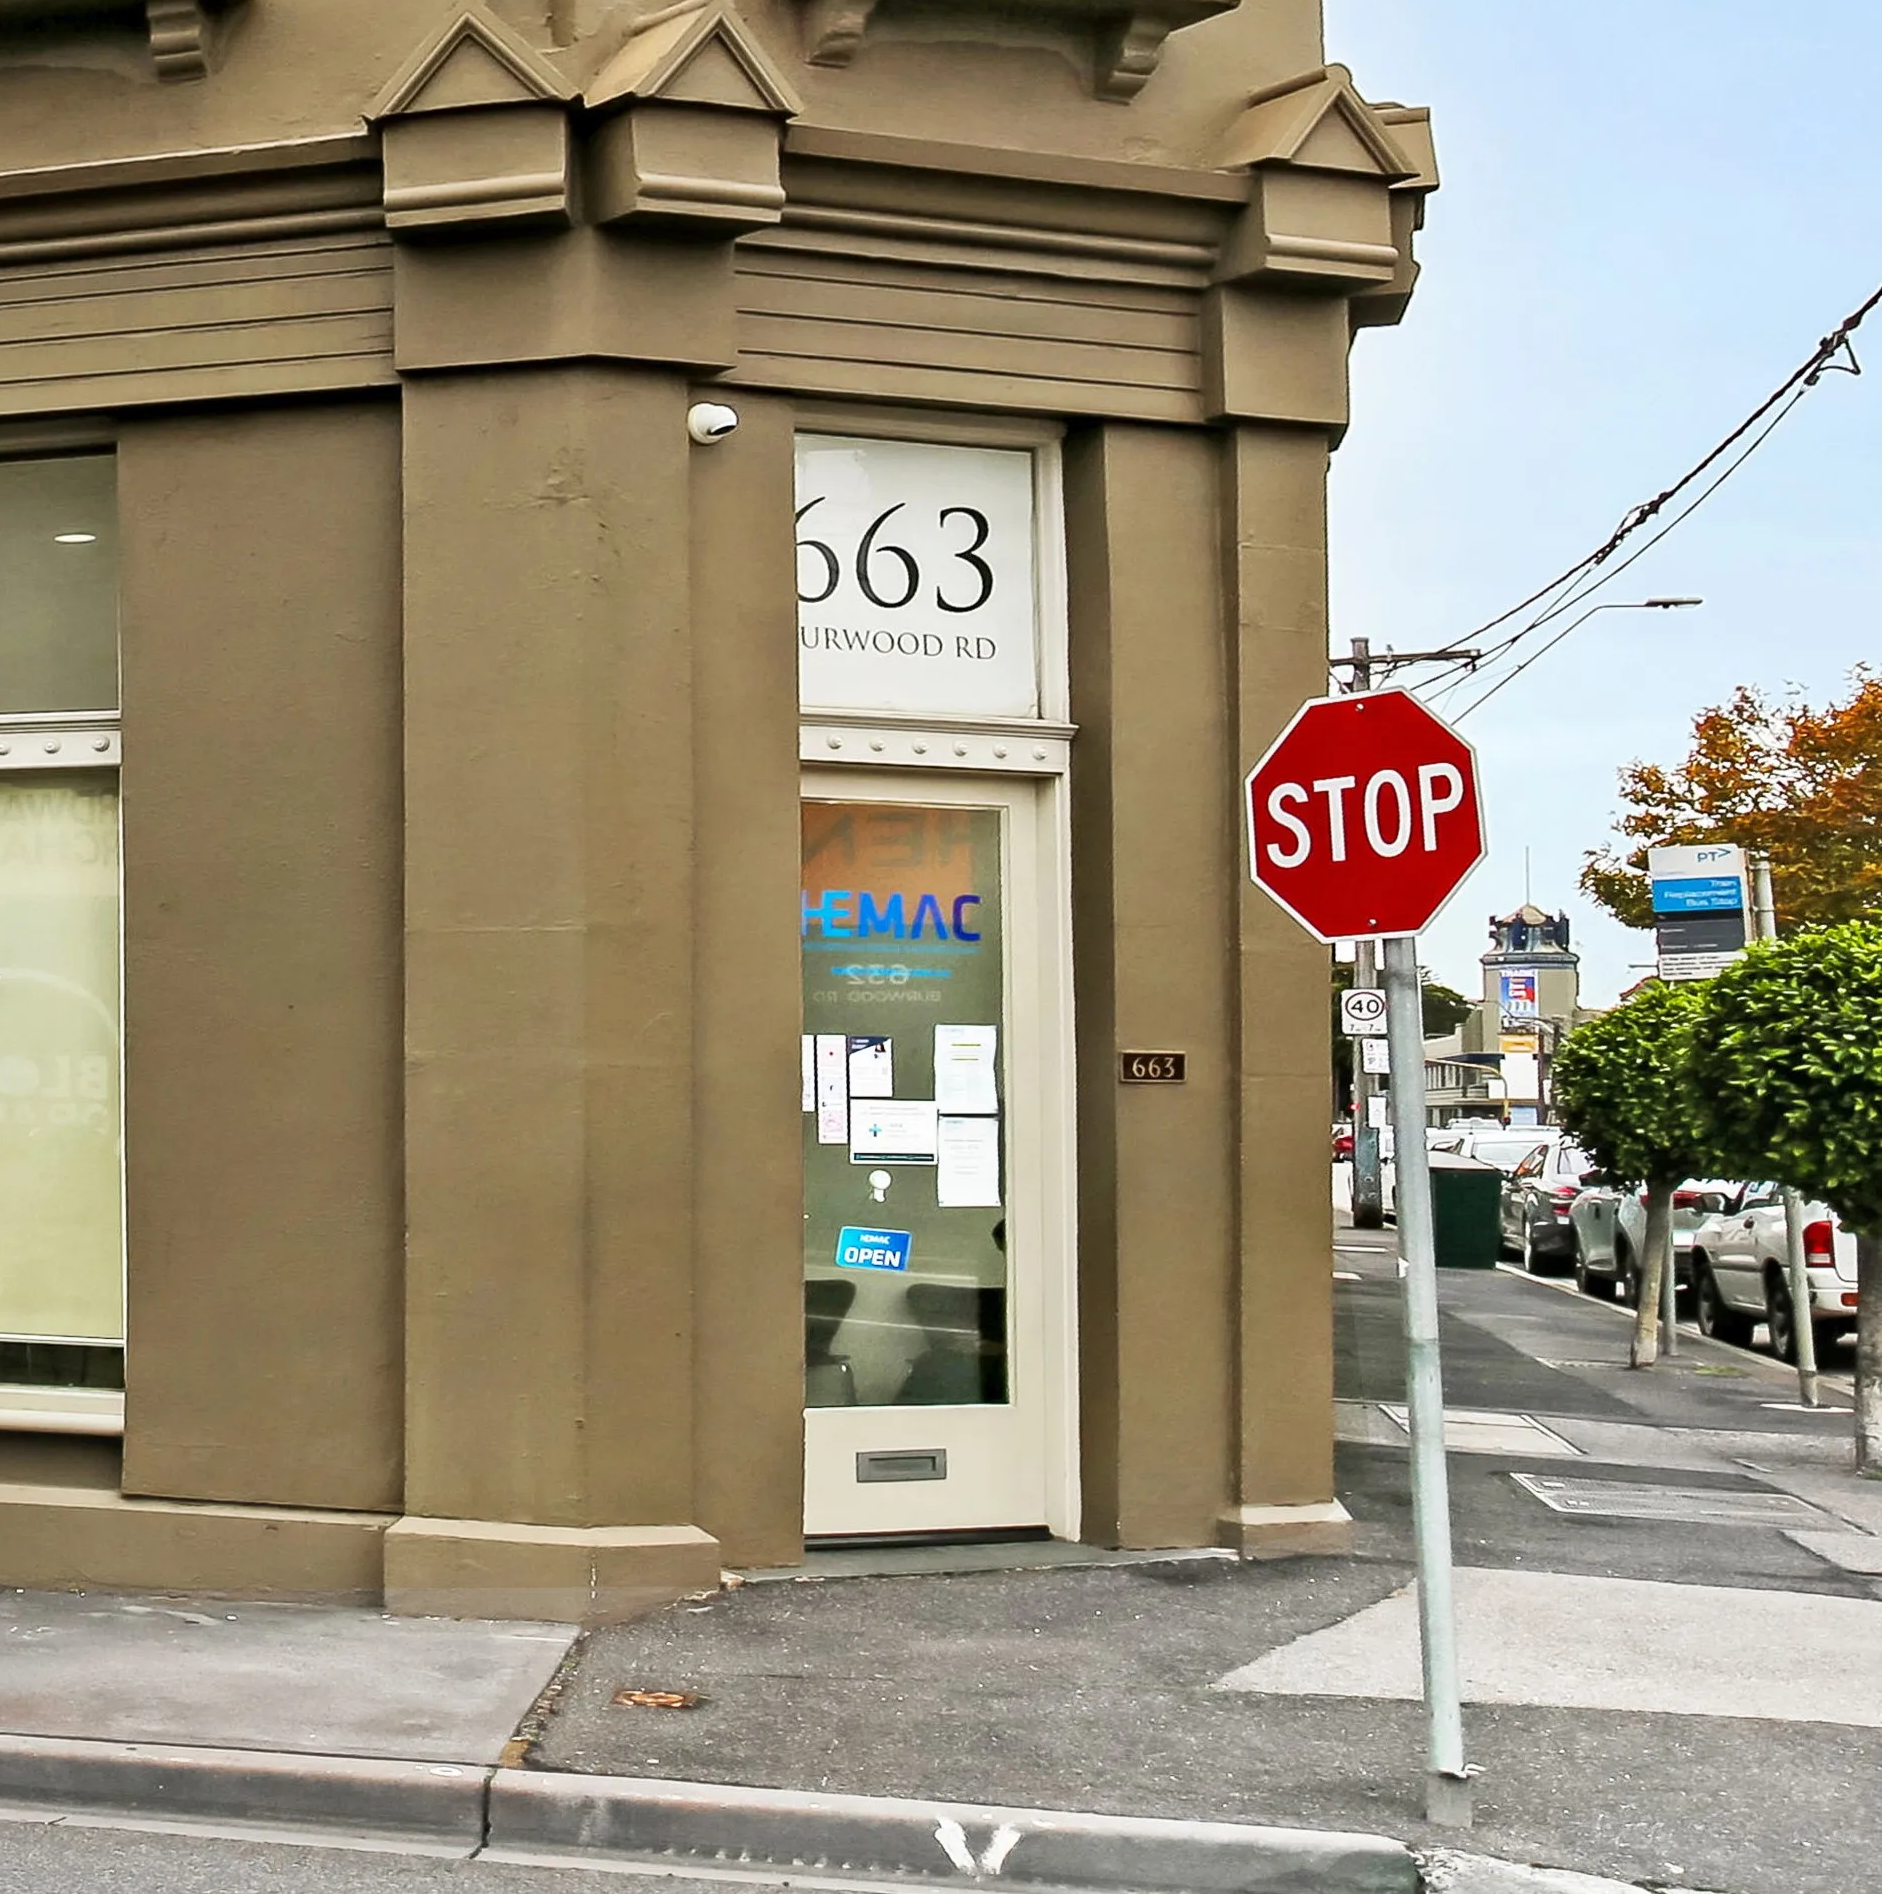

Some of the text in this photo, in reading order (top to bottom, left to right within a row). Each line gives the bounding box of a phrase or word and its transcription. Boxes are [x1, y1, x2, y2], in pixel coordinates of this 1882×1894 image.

[795, 496, 993, 614] 663
[955, 635, 997, 660] RD
[1266, 762, 1464, 869] STOP
[1351, 999, 1379, 1014] 40
[1131, 1057, 1175, 1079] 663
[844, 1246, 901, 1268] OPEN
